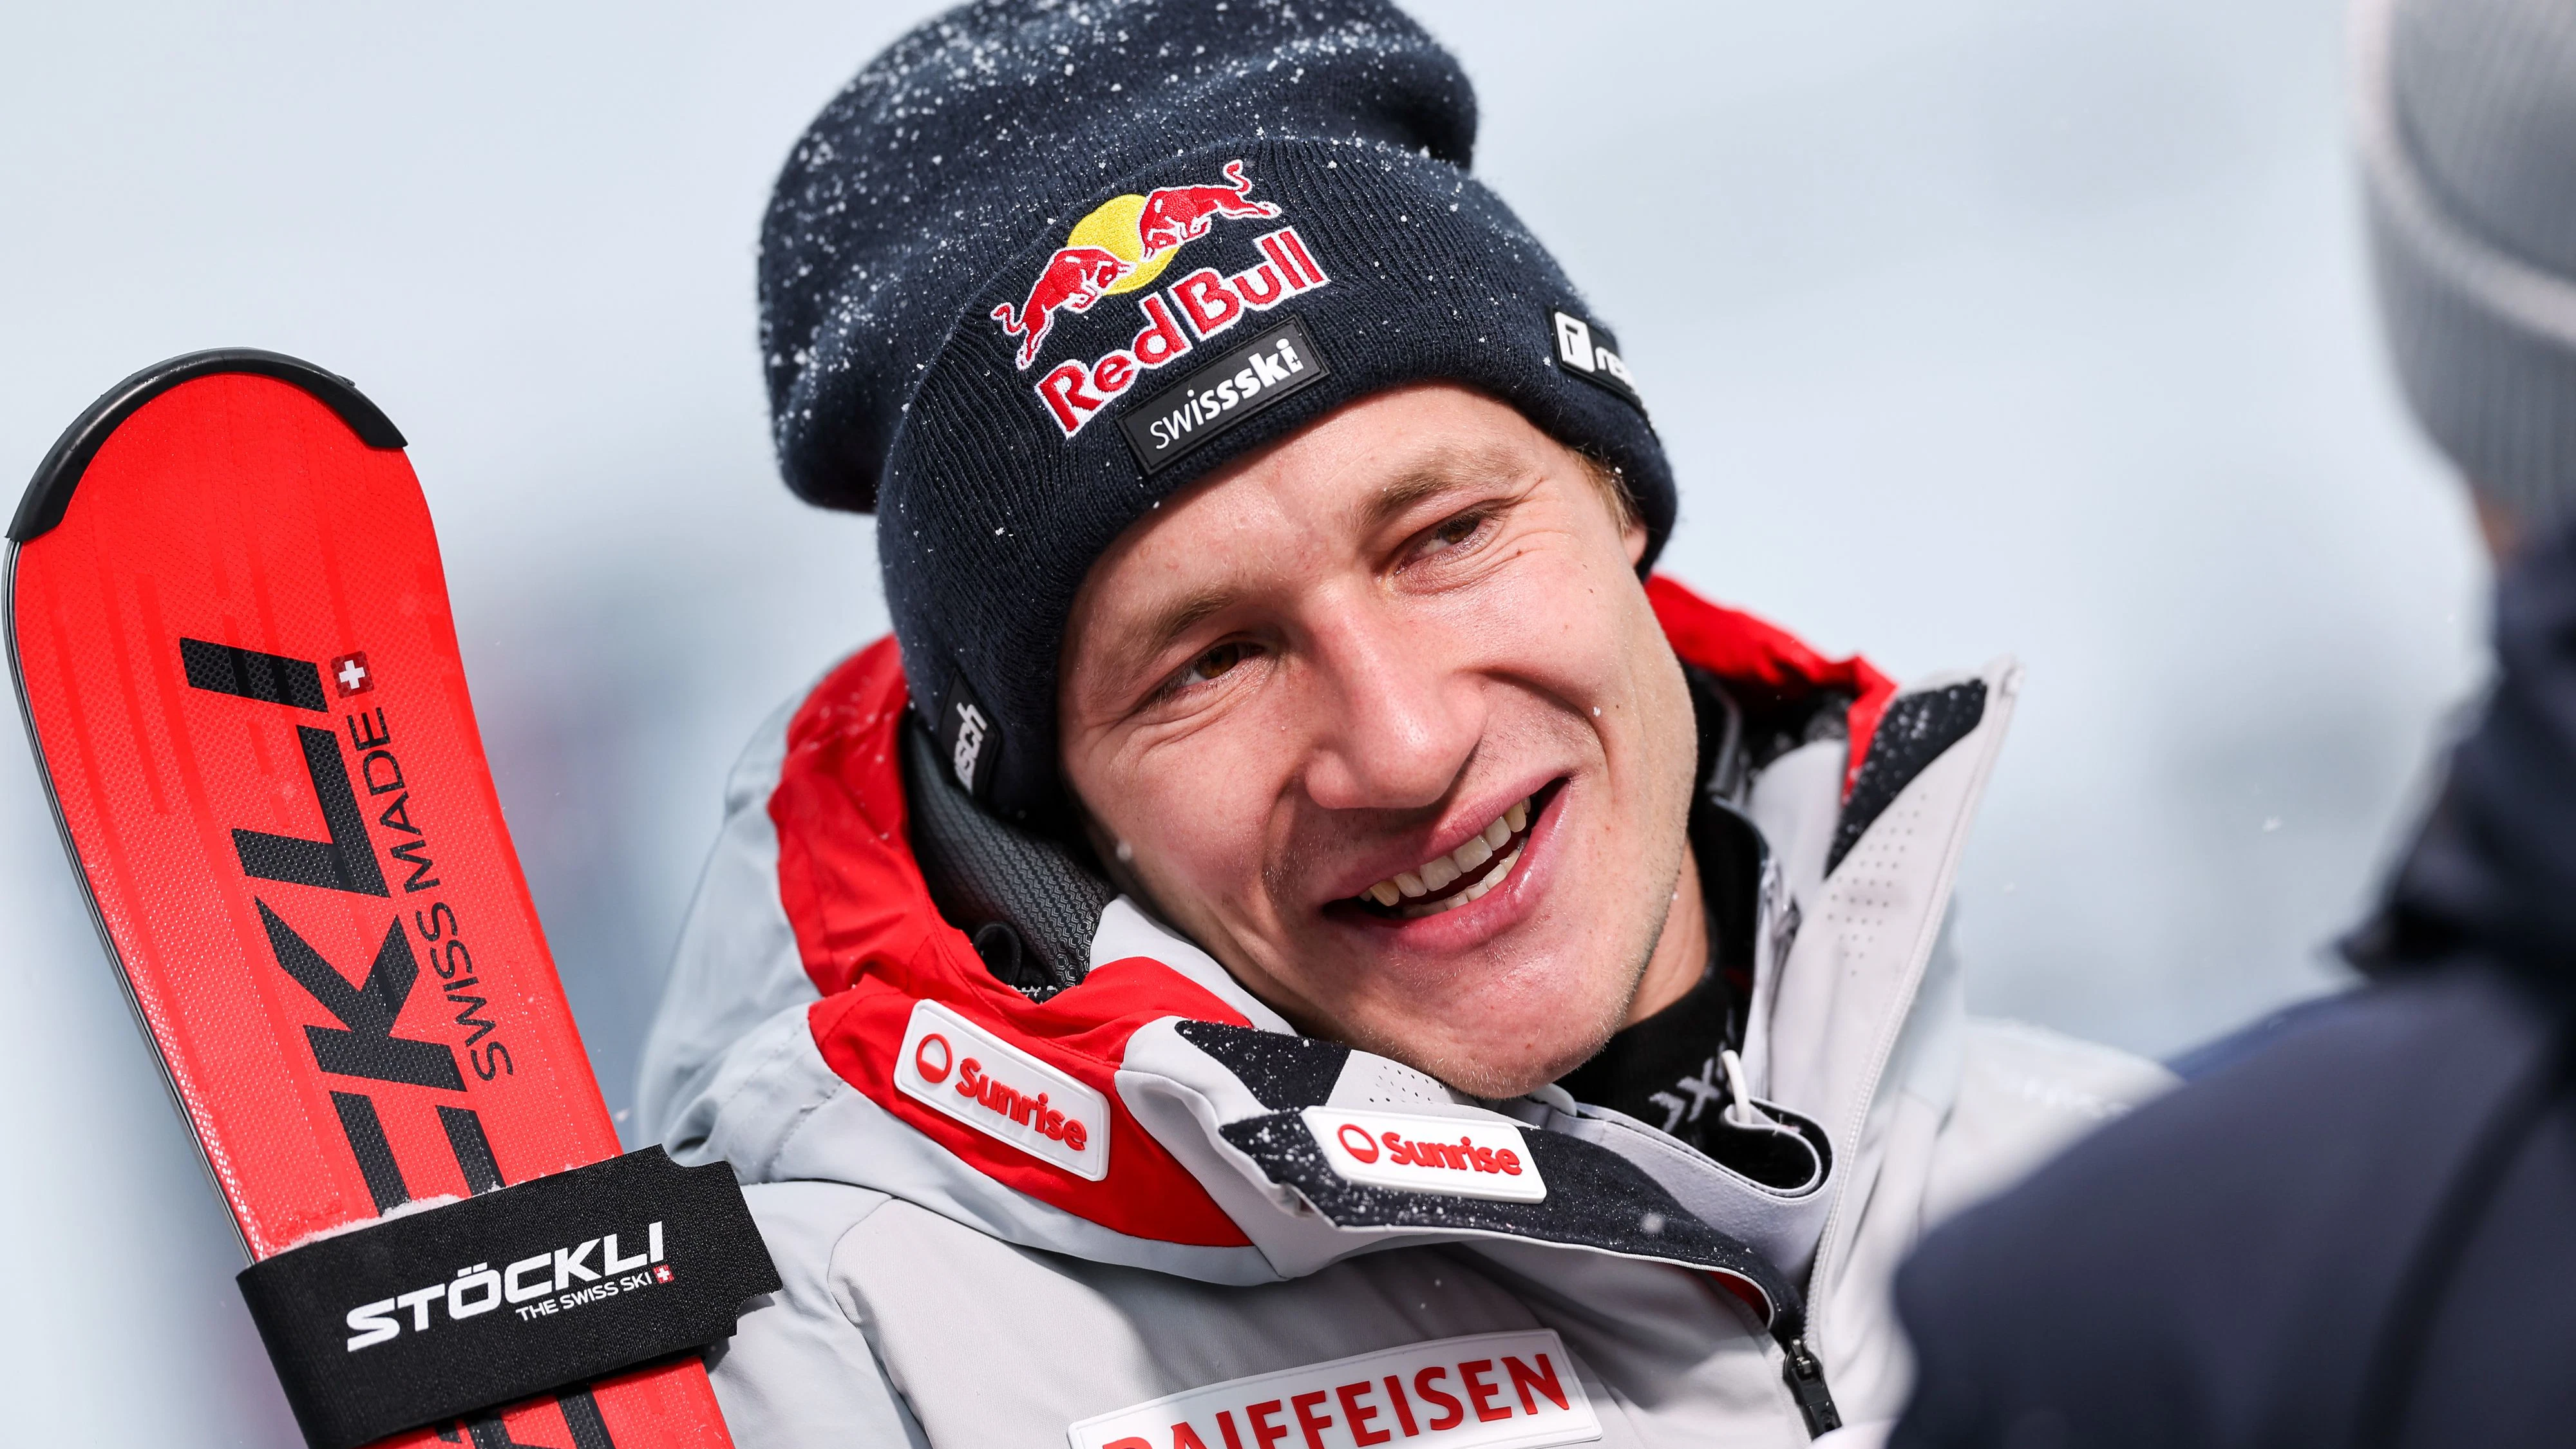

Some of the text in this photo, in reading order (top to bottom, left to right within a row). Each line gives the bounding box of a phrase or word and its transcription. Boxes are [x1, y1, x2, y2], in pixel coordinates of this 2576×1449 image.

[1036, 226, 1329, 437] Red Bull
[1150, 337, 1304, 450] swissski
[347, 706, 514, 1081] SWISS MADE
[954, 1057, 1087, 1151] Sunrise
[1381, 1131, 1523, 1176] Sunrise
[346, 1220, 665, 1352] STÖCKLI
[515, 1271, 652, 1321] THE SWISS SKI
